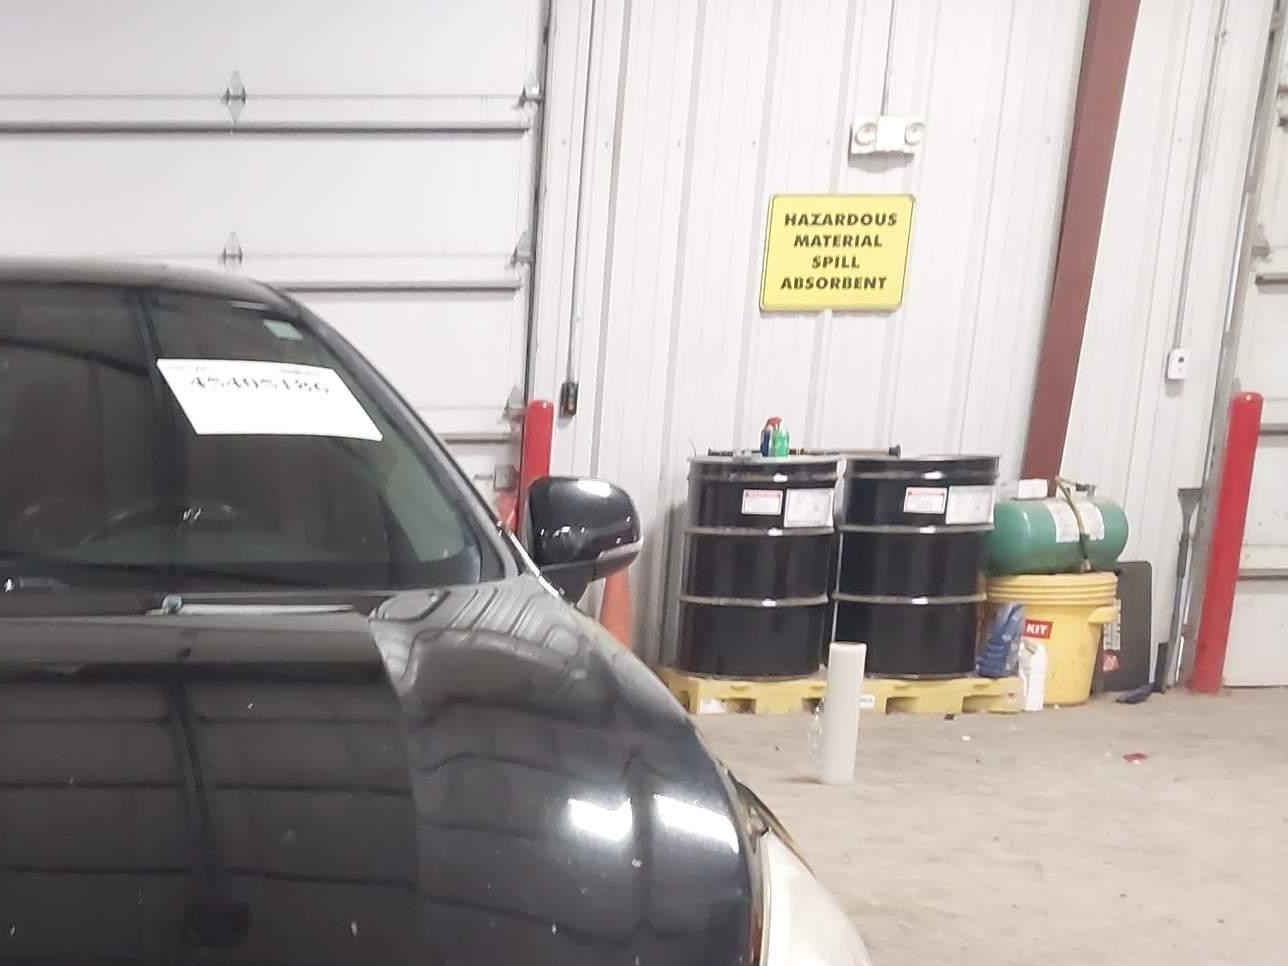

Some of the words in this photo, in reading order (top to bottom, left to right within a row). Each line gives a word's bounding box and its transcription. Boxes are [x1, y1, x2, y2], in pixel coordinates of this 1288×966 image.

[784, 213, 898, 226] HAZARDOUS
[793, 235, 883, 248] MATERIAL
[811, 256, 861, 269] SPILL
[780, 277, 888, 290] ABSORBENT
[1026, 623, 1048, 635] KIT
